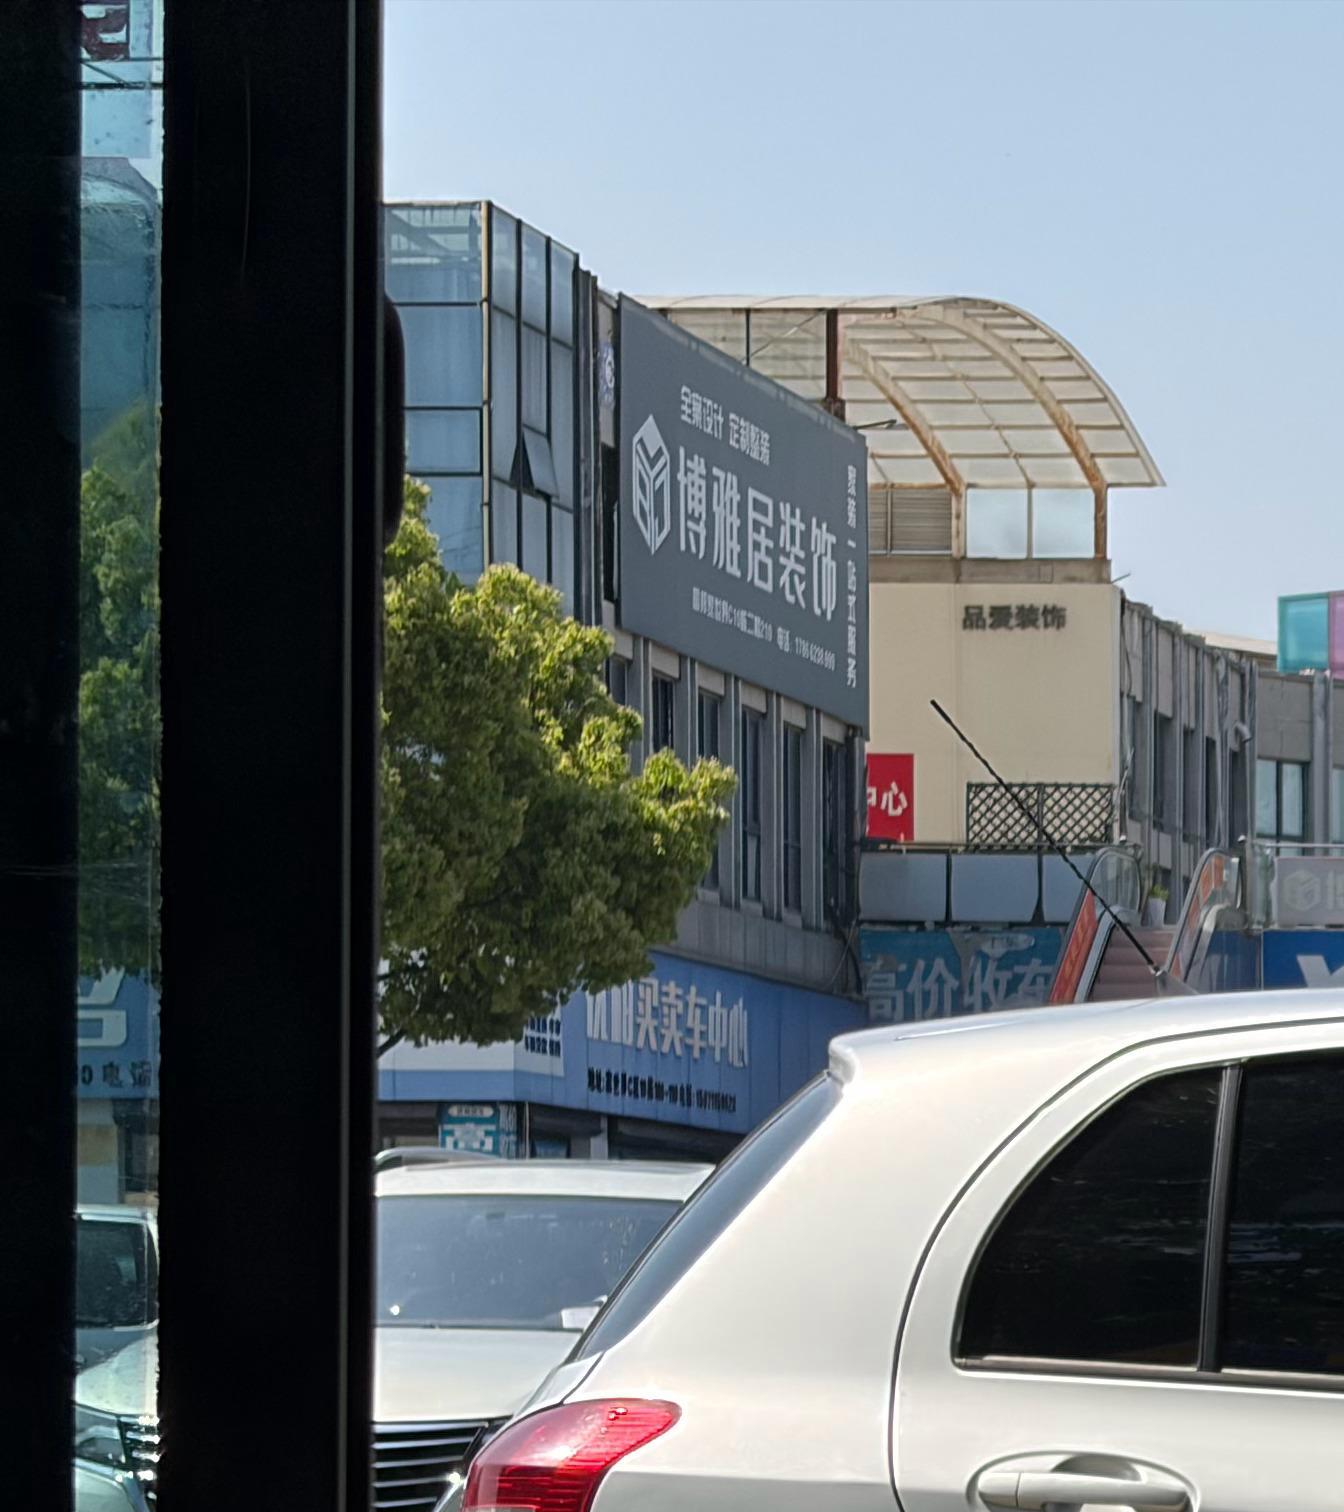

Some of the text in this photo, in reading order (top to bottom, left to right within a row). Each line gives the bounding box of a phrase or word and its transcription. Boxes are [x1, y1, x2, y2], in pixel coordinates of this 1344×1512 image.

[677, 446, 837, 621] 博雅居装饰
[962, 604, 1066, 631] 品爱装饰
